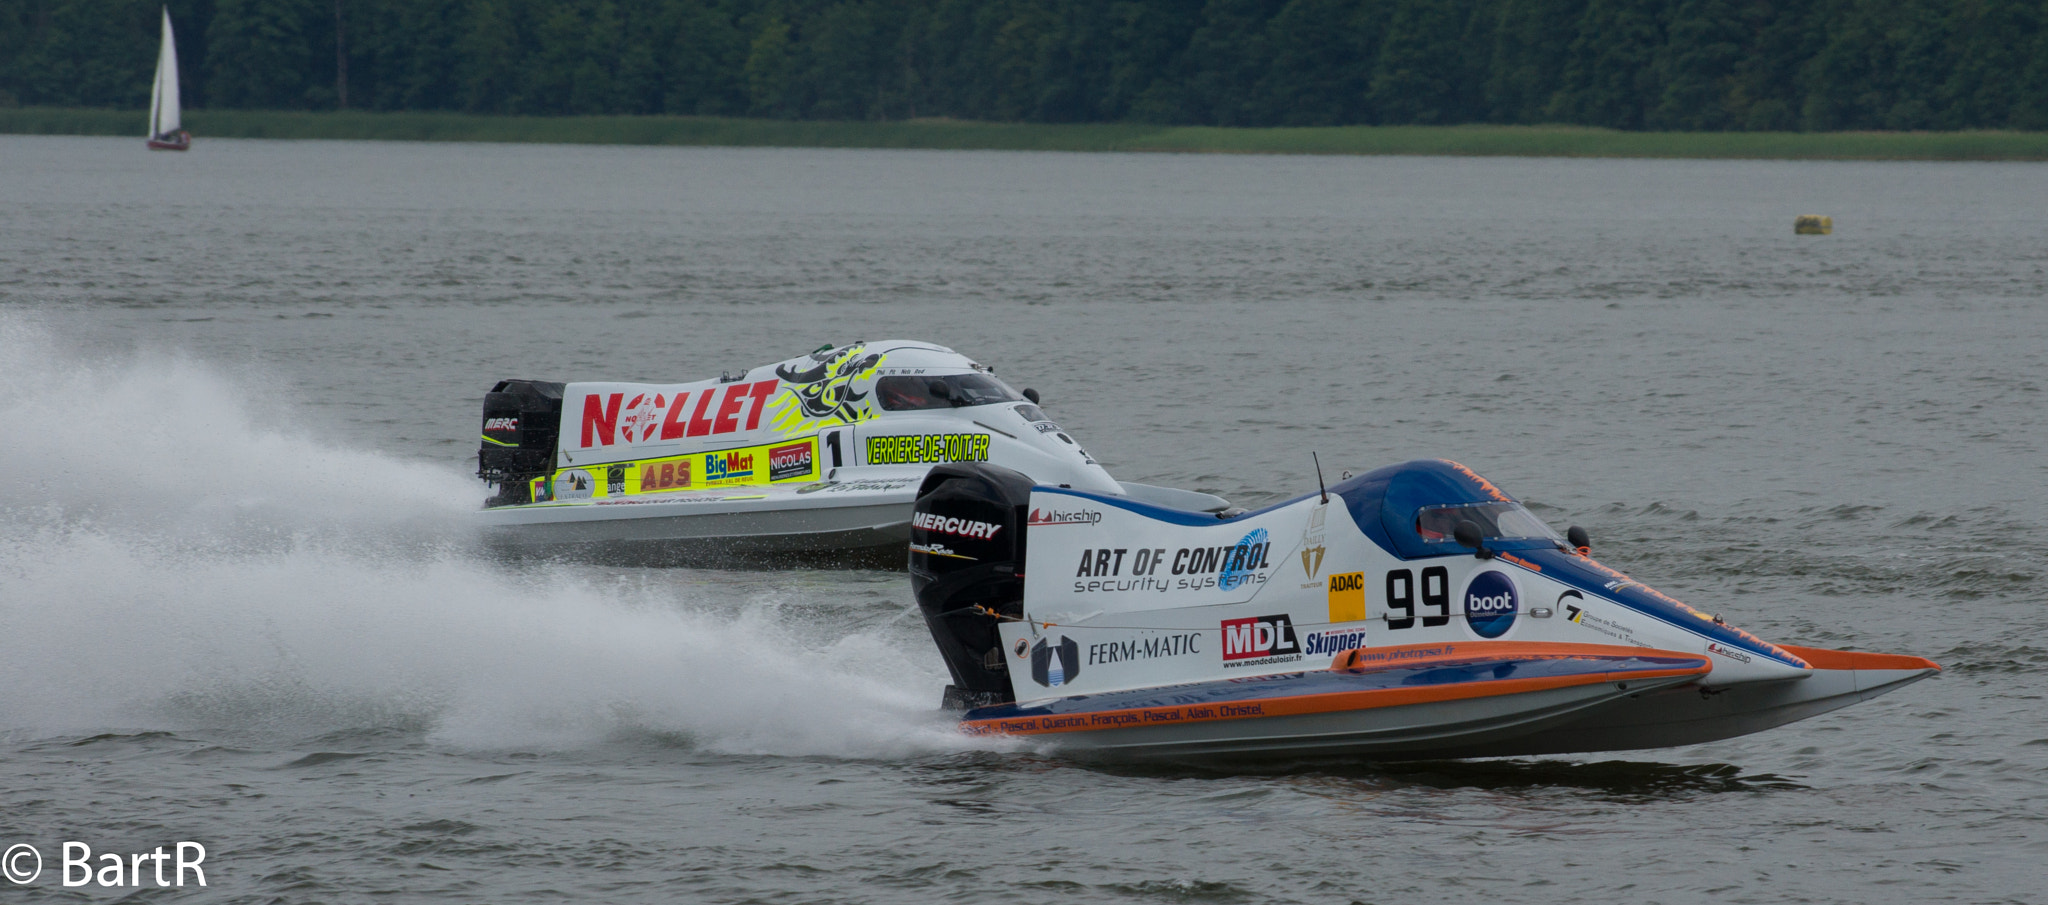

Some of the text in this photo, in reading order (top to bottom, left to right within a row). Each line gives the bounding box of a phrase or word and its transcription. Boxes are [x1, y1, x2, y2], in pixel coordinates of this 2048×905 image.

[485, 417, 519, 432] MERC
[580, 378, 780, 448] NOLLET
[625, 414, 656, 423] NOET
[770, 451, 811, 471] NICOLAS
[826, 430, 843, 468] 1
[866, 433, 990, 465] VERRIERE-DE-TOIT.FR
[641, 461, 691, 490] ABS
[705, 451, 754, 478] BigMat
[912, 511, 1002, 541] MERCURY
[1076, 541, 1272, 577] ART OF CONTROL
[1073, 572, 1267, 593] security systems
[1329, 573, 1363, 593] ADAC
[1386, 565, 1450, 631] 99
[1470, 591, 1513, 612] boot
[1088, 632, 1202, 666] FERM-MATIC
[1226, 619, 1294, 655] MDL
[1223, 654, 1302, 669] www.mondeduloisir.fr
